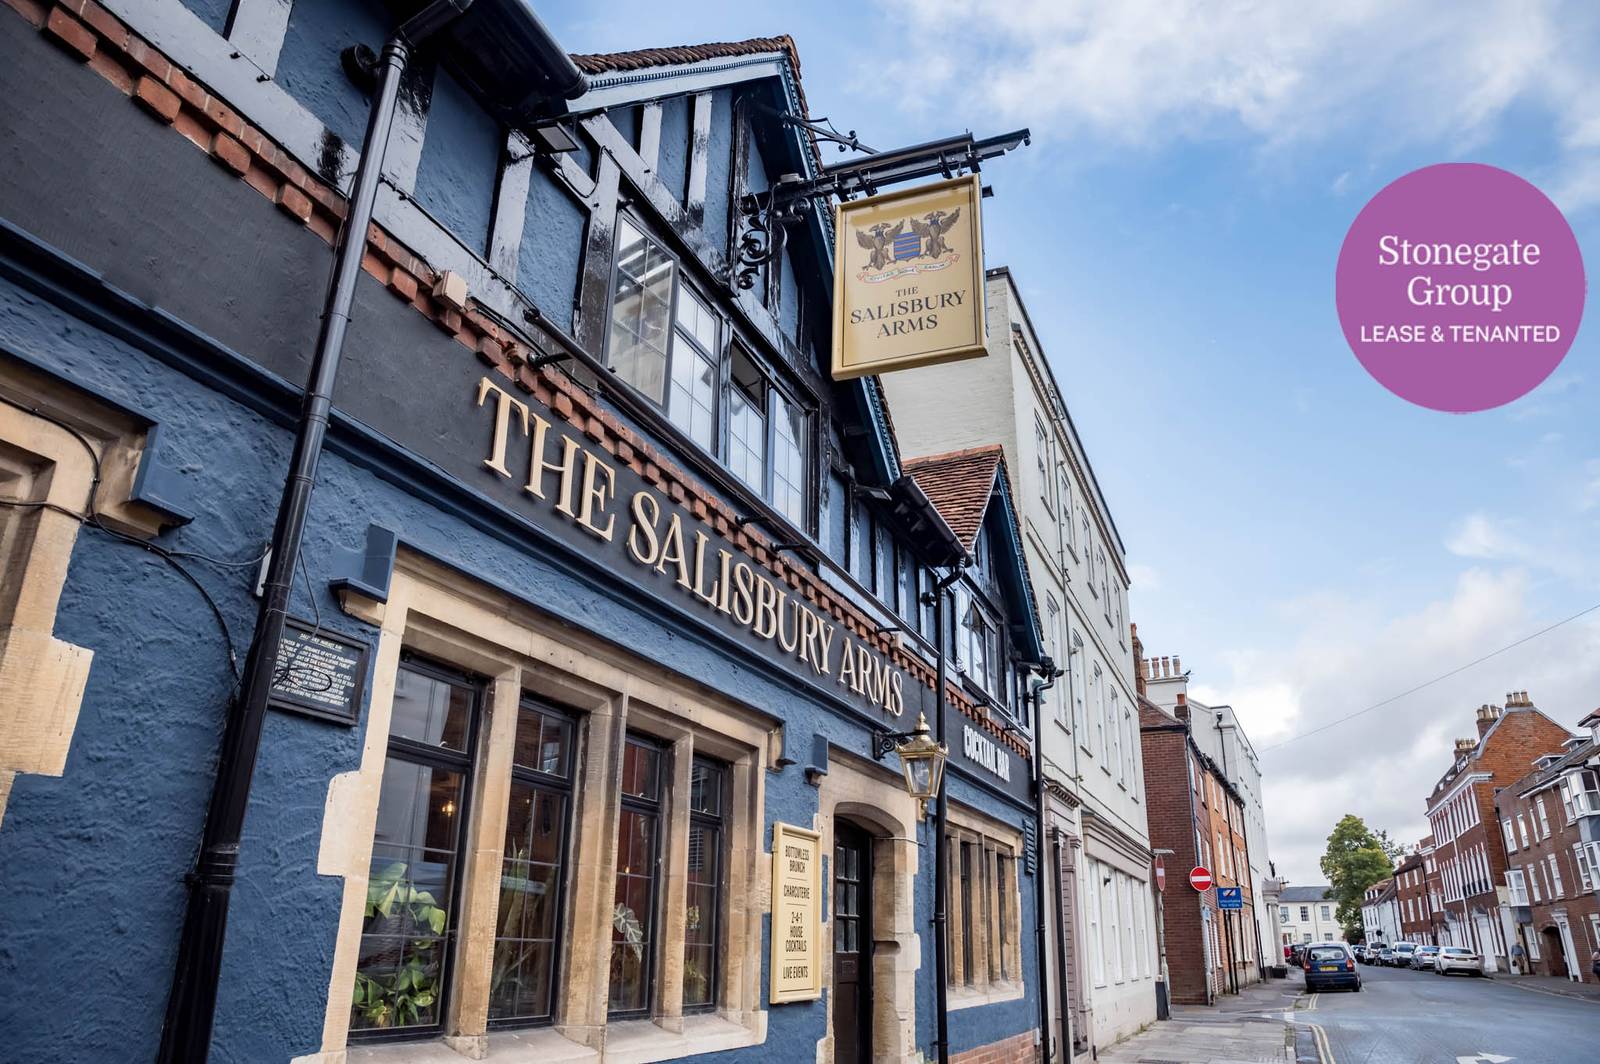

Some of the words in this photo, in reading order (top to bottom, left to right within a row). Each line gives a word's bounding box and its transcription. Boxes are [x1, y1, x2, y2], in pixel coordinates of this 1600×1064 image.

[896, 286, 919, 298] THE
[850, 290, 966, 325] SALISBURY
[877, 314, 938, 338] ARMS
[477, 376, 616, 542] THE
[627, 491, 834, 675] SALISBURY
[839, 637, 903, 717] ARMS
[964, 725, 997, 775] COCKTAIL
[997, 748, 1011, 782] BAR
[785, 845, 809, 861] BOTTOMLESS
[789, 861, 806, 873] BRUNCH
[783, 884, 810, 899] CHARCUTERIE
[791, 911, 803, 924] 2-4-1
[789, 926, 803, 938] HOUSE
[785, 940, 807, 953] COCKTAILS
[783, 966, 793, 980] LIVE
[793, 965, 809, 979] EVENTS
